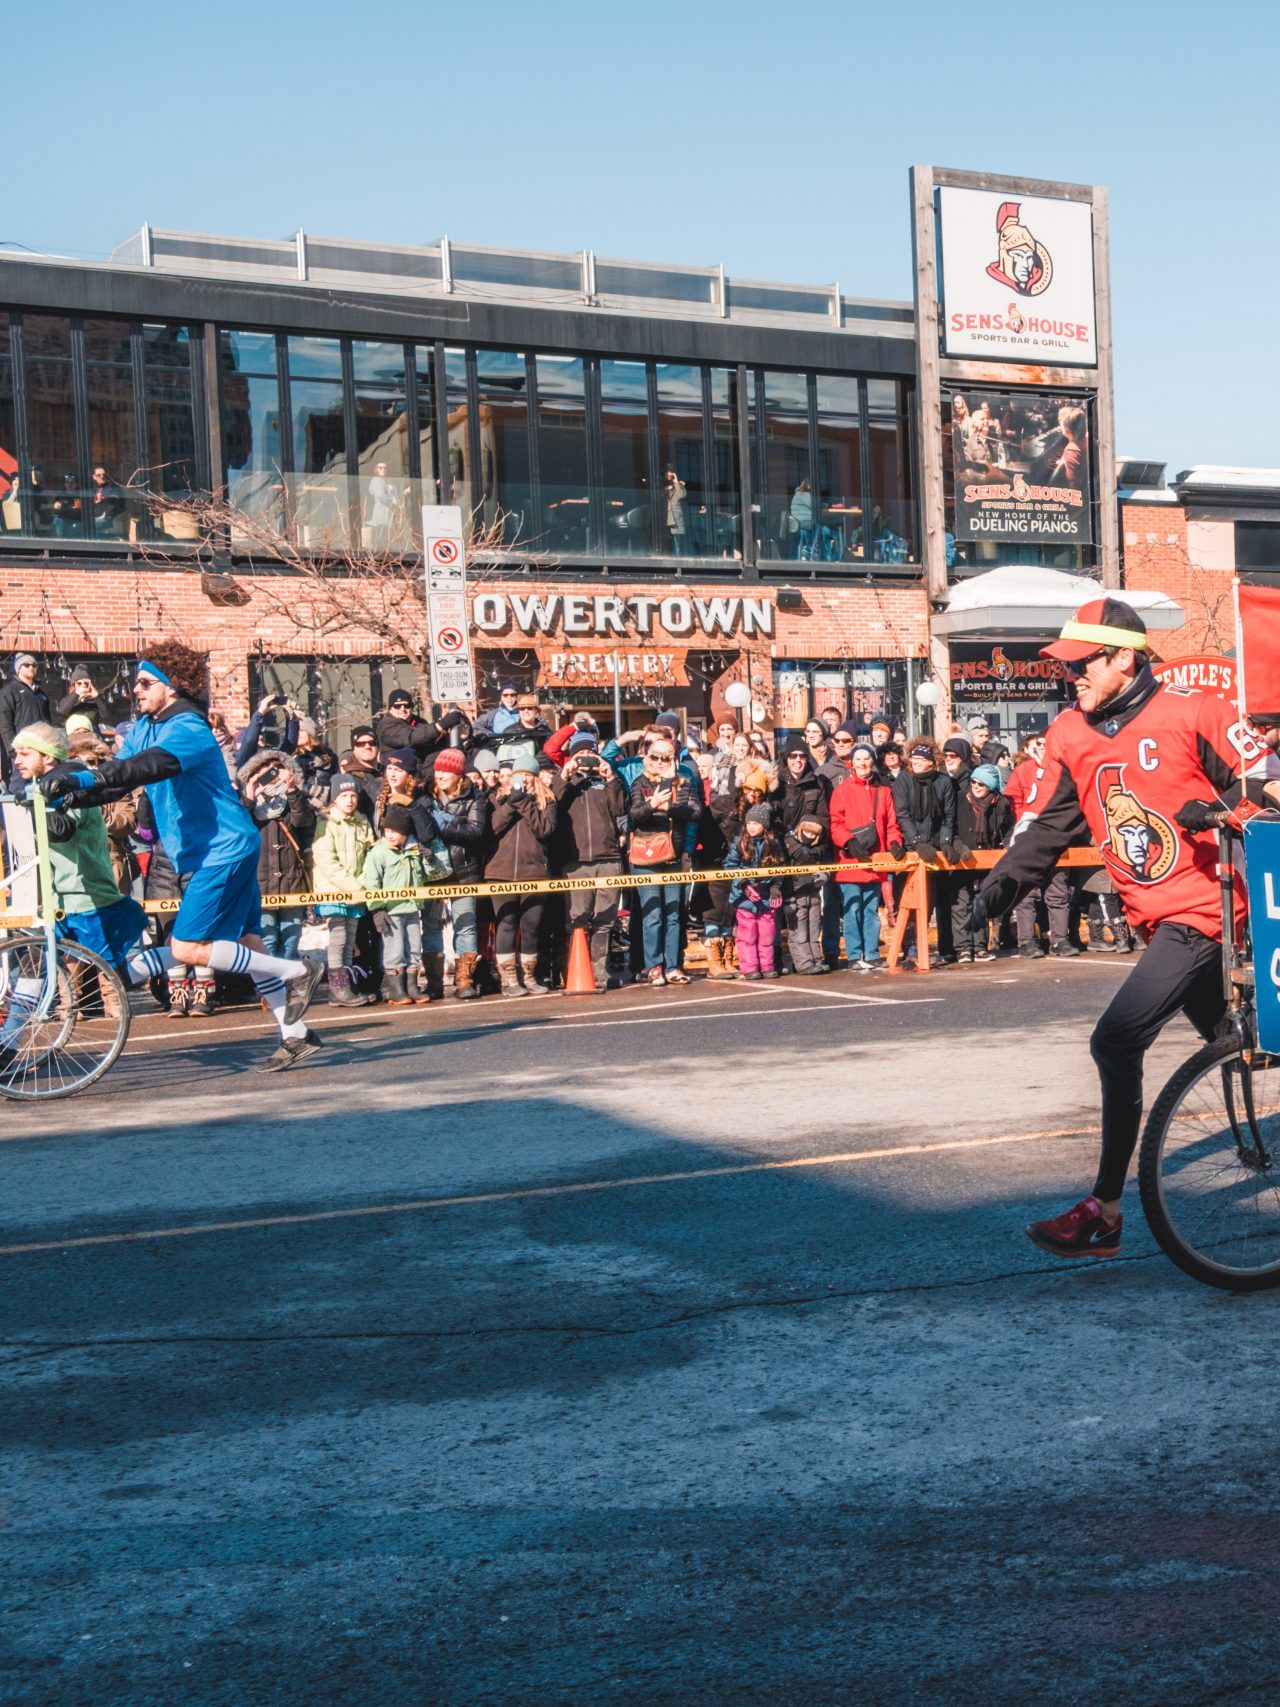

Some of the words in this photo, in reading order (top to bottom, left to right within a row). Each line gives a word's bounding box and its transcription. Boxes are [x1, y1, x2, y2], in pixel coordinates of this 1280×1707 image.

[951, 313, 1004, 332] SENS
[1028, 317, 1089, 342] HOUSE
[970, 333, 1008, 343] SPORTS
[1010, 336, 1030, 345] BAR
[1041, 339, 1070, 348] GRILL
[964, 484, 1012, 503] SENS
[1030, 485, 1083, 507] HOUSE
[981, 501, 1015, 510] SPORTS
[1015, 502, 1034, 511] BAR
[1041, 503, 1067, 512] GRILL
[978, 511, 999, 519] NEW
[1005, 512, 1032, 520] HOME
[1053, 513, 1070, 521] THE
[970, 518, 1028, 532] DUELING
[1031, 520, 1078, 534] PIANOS
[469, 593, 772, 633] OWERTOWN
[551, 653, 675, 674] BREWERY
[440, 671, 468, 679] THU-SUN
[950, 660, 989, 680] ENS
[442, 680, 468, 688] JEU-DIM
[954, 682, 993, 691] SPORTS
[995, 682, 1017, 690] BAR
[1018, 682, 1025, 690] &
[1027, 682, 1058, 690] GRILL
[1138, 737, 1159, 771] C
[661, 873, 706, 883] CAUTION
[715, 870, 759, 879] CAUTION
[549, 879, 596, 889] CAUTION
[606, 876, 652, 886] CAUTION
[428, 886, 479, 897] CAUTION
[489, 883, 538, 893] CAUTION
[299, 893, 353, 903] CAUTION
[365, 889, 417, 900] CAUTION
